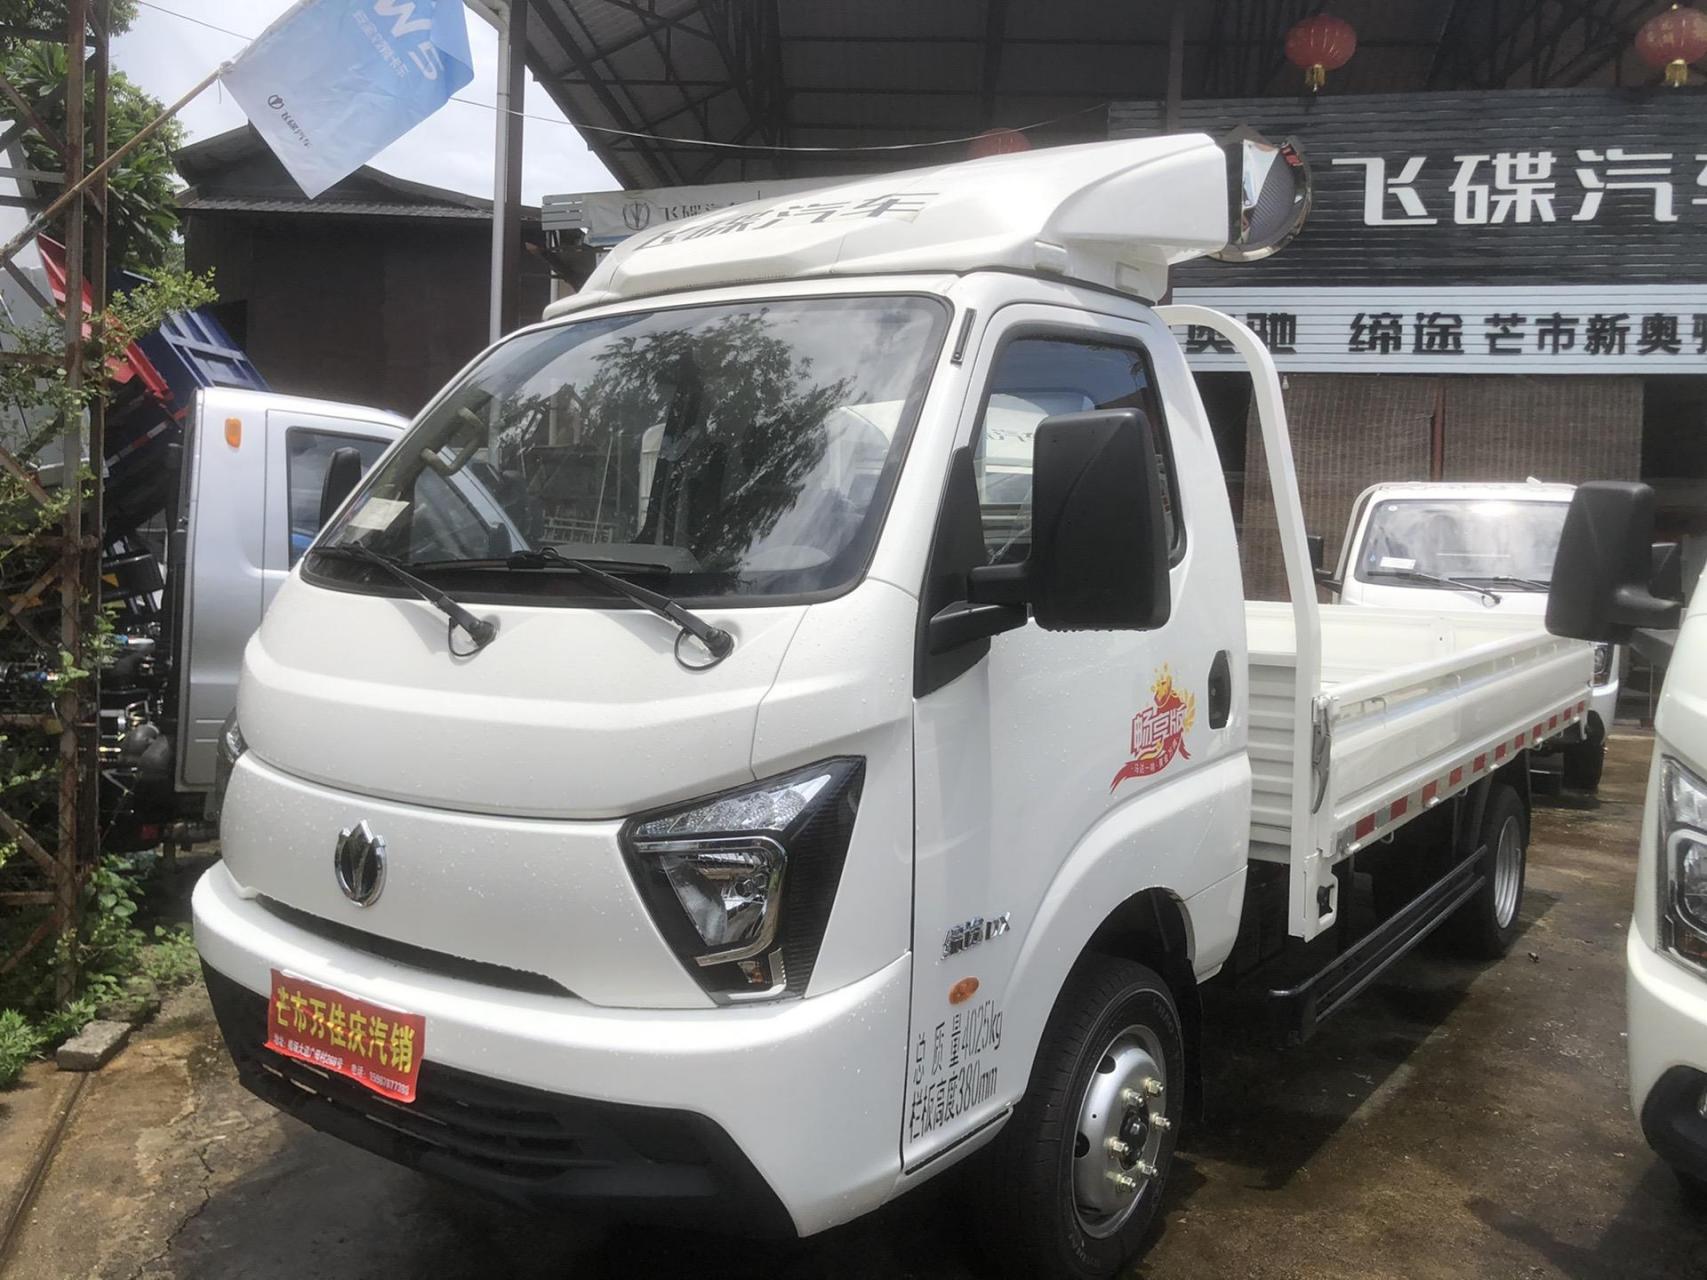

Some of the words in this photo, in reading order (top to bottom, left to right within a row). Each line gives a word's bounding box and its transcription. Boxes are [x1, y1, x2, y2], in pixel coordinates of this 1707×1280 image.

[1332, 146, 1707, 226] 飞碟汽
[633, 192, 939, 251] 飞碟汽车
[1349, 311, 1465, 355] 缔途
